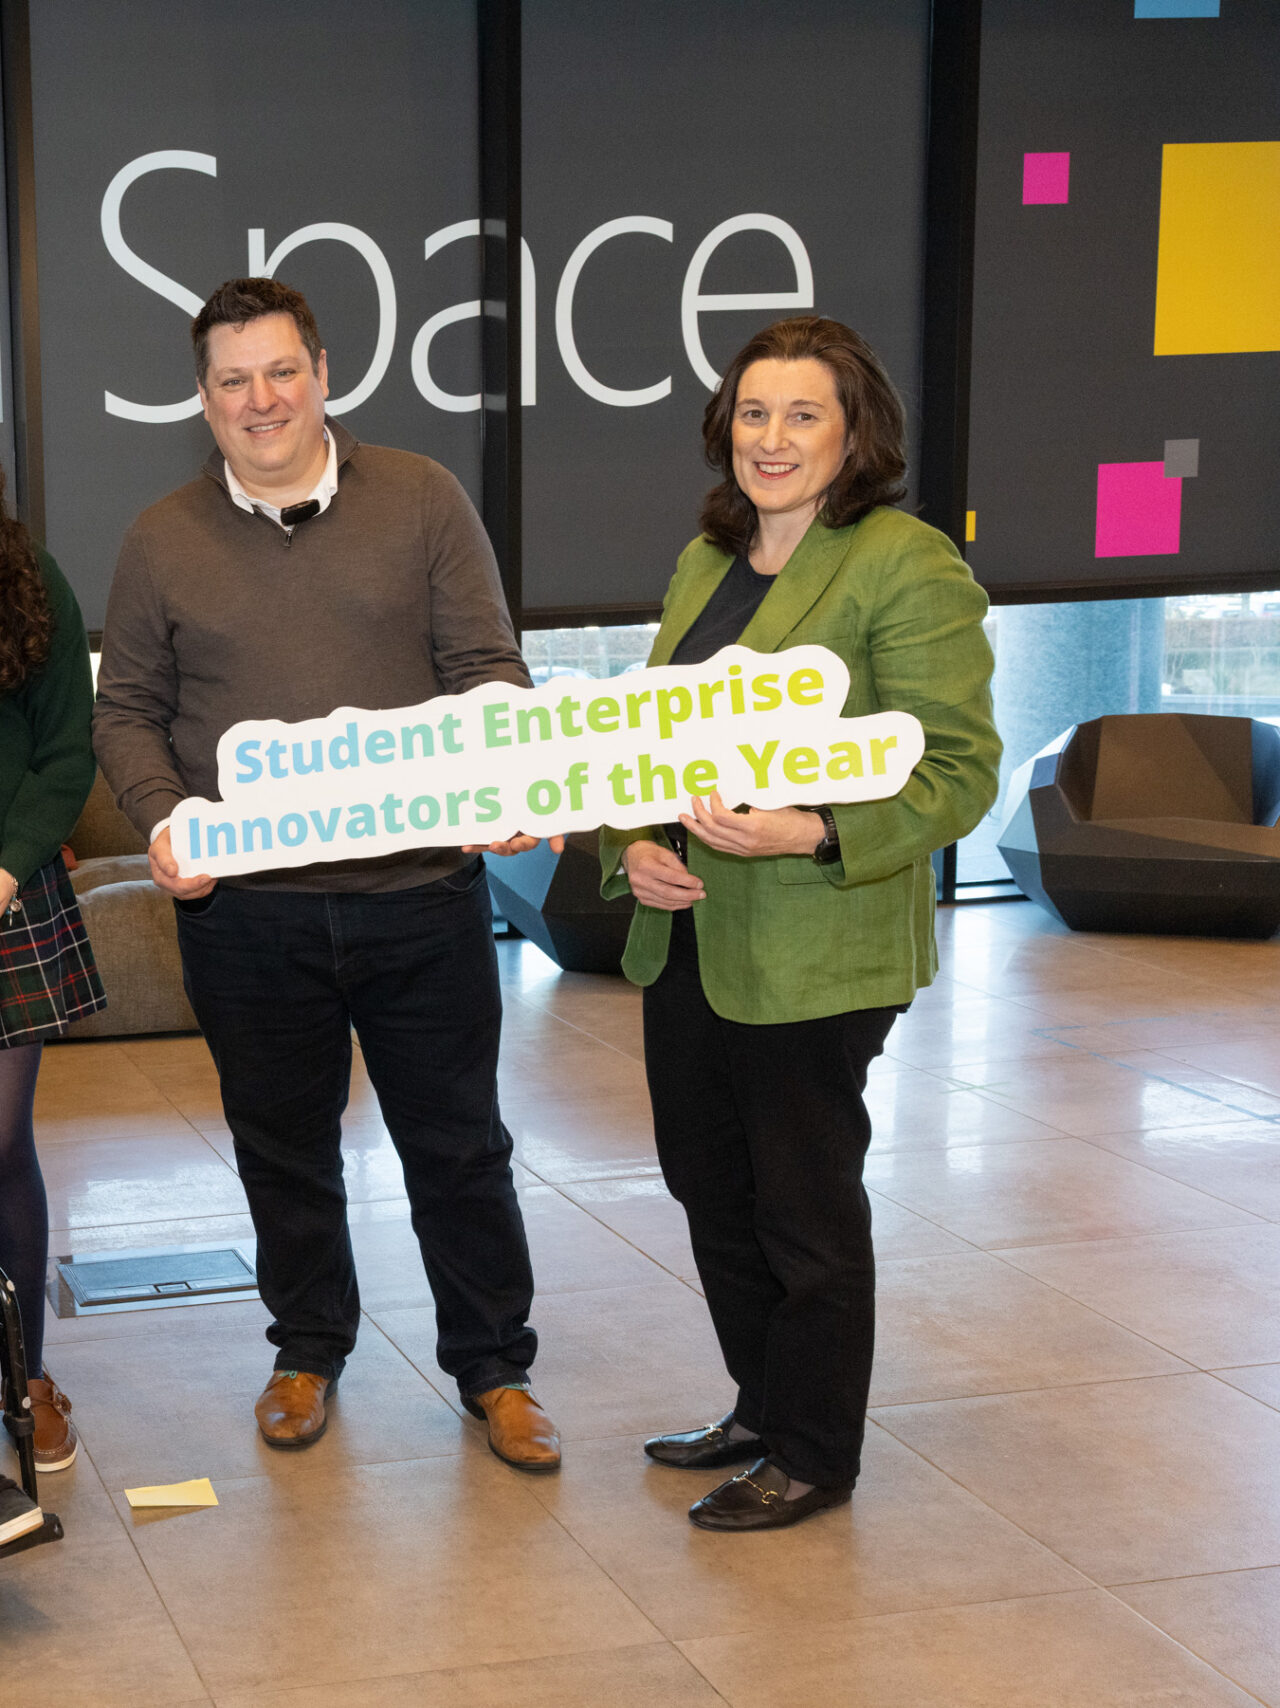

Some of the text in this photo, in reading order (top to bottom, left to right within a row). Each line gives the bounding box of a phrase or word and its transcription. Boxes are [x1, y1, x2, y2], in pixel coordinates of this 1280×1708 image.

[100, 149, 815, 424] Space
[234, 664, 826, 784] Student Enterprise
[188, 733, 899, 861] Innovators of the Year
